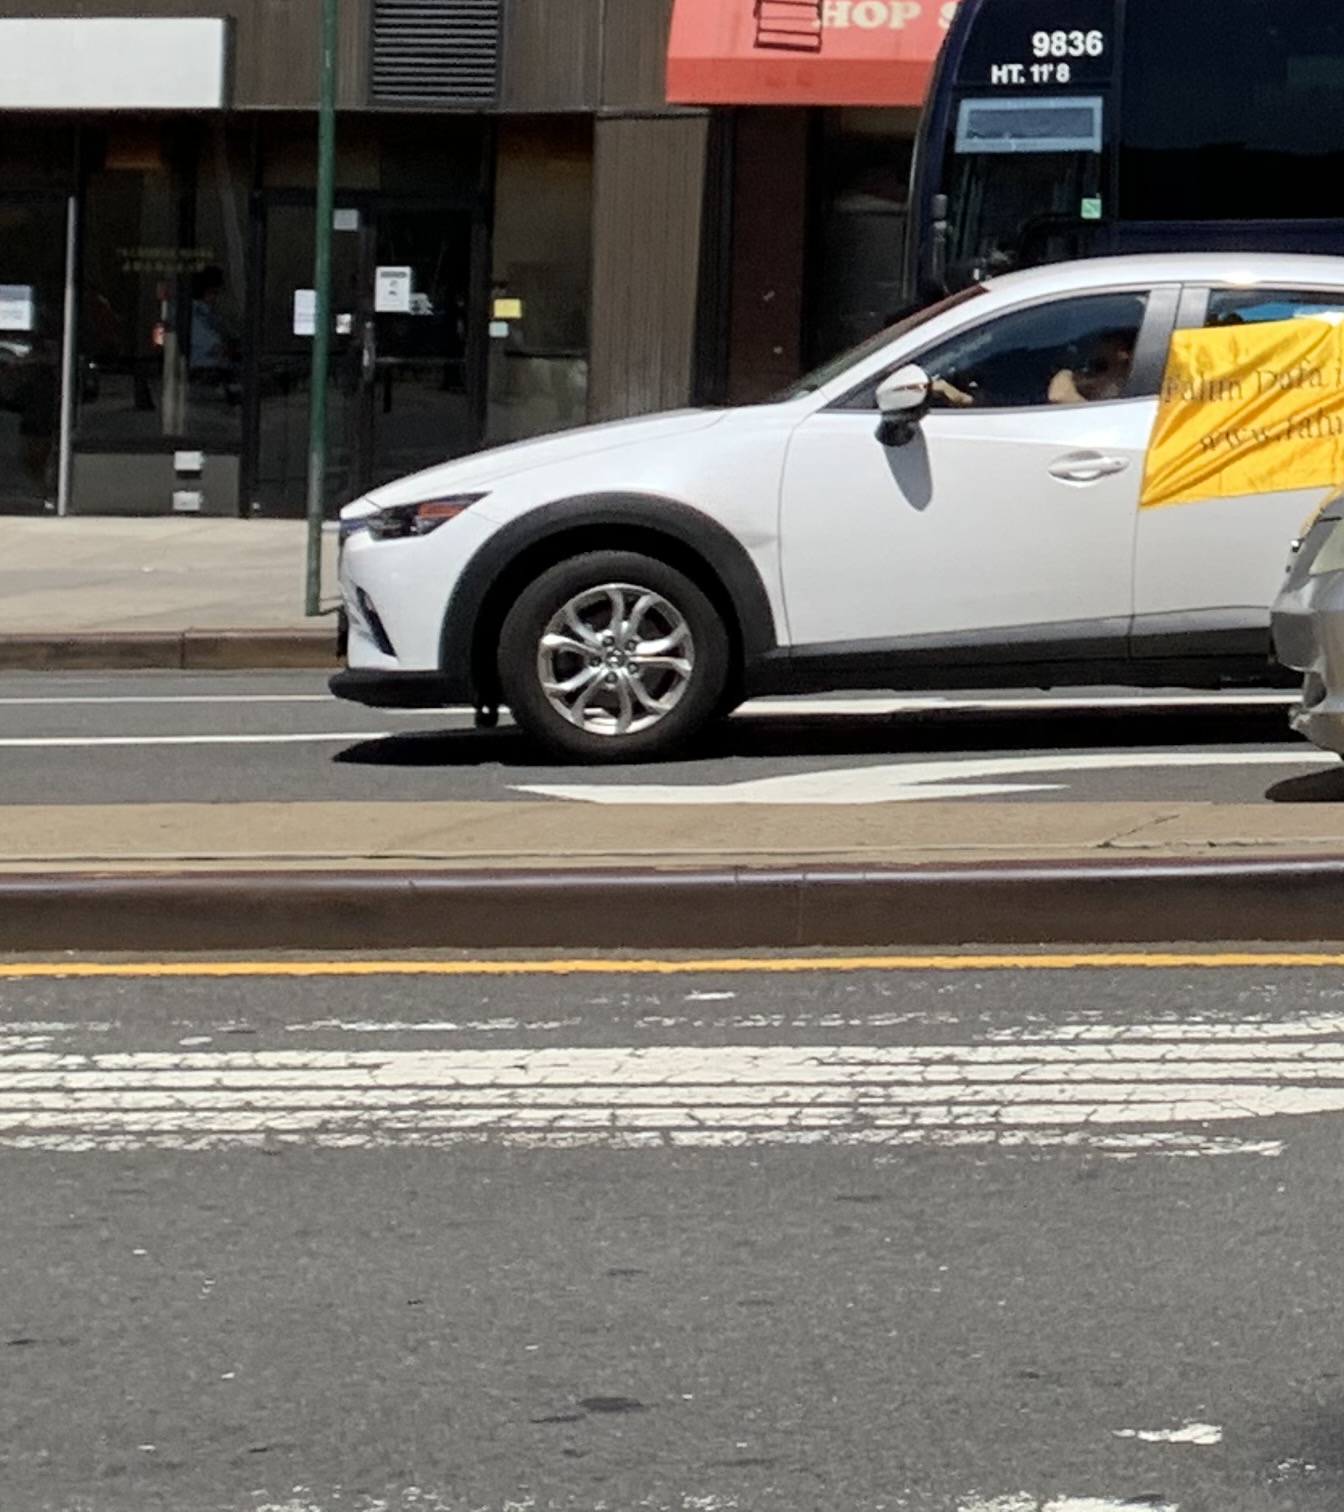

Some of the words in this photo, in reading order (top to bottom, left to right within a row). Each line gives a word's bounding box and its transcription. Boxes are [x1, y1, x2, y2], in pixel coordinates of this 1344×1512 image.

[1031, 30, 1104, 57] 9836
[990, 64, 1026, 85] HT.
[1253, 360, 1323, 393] Dafa
